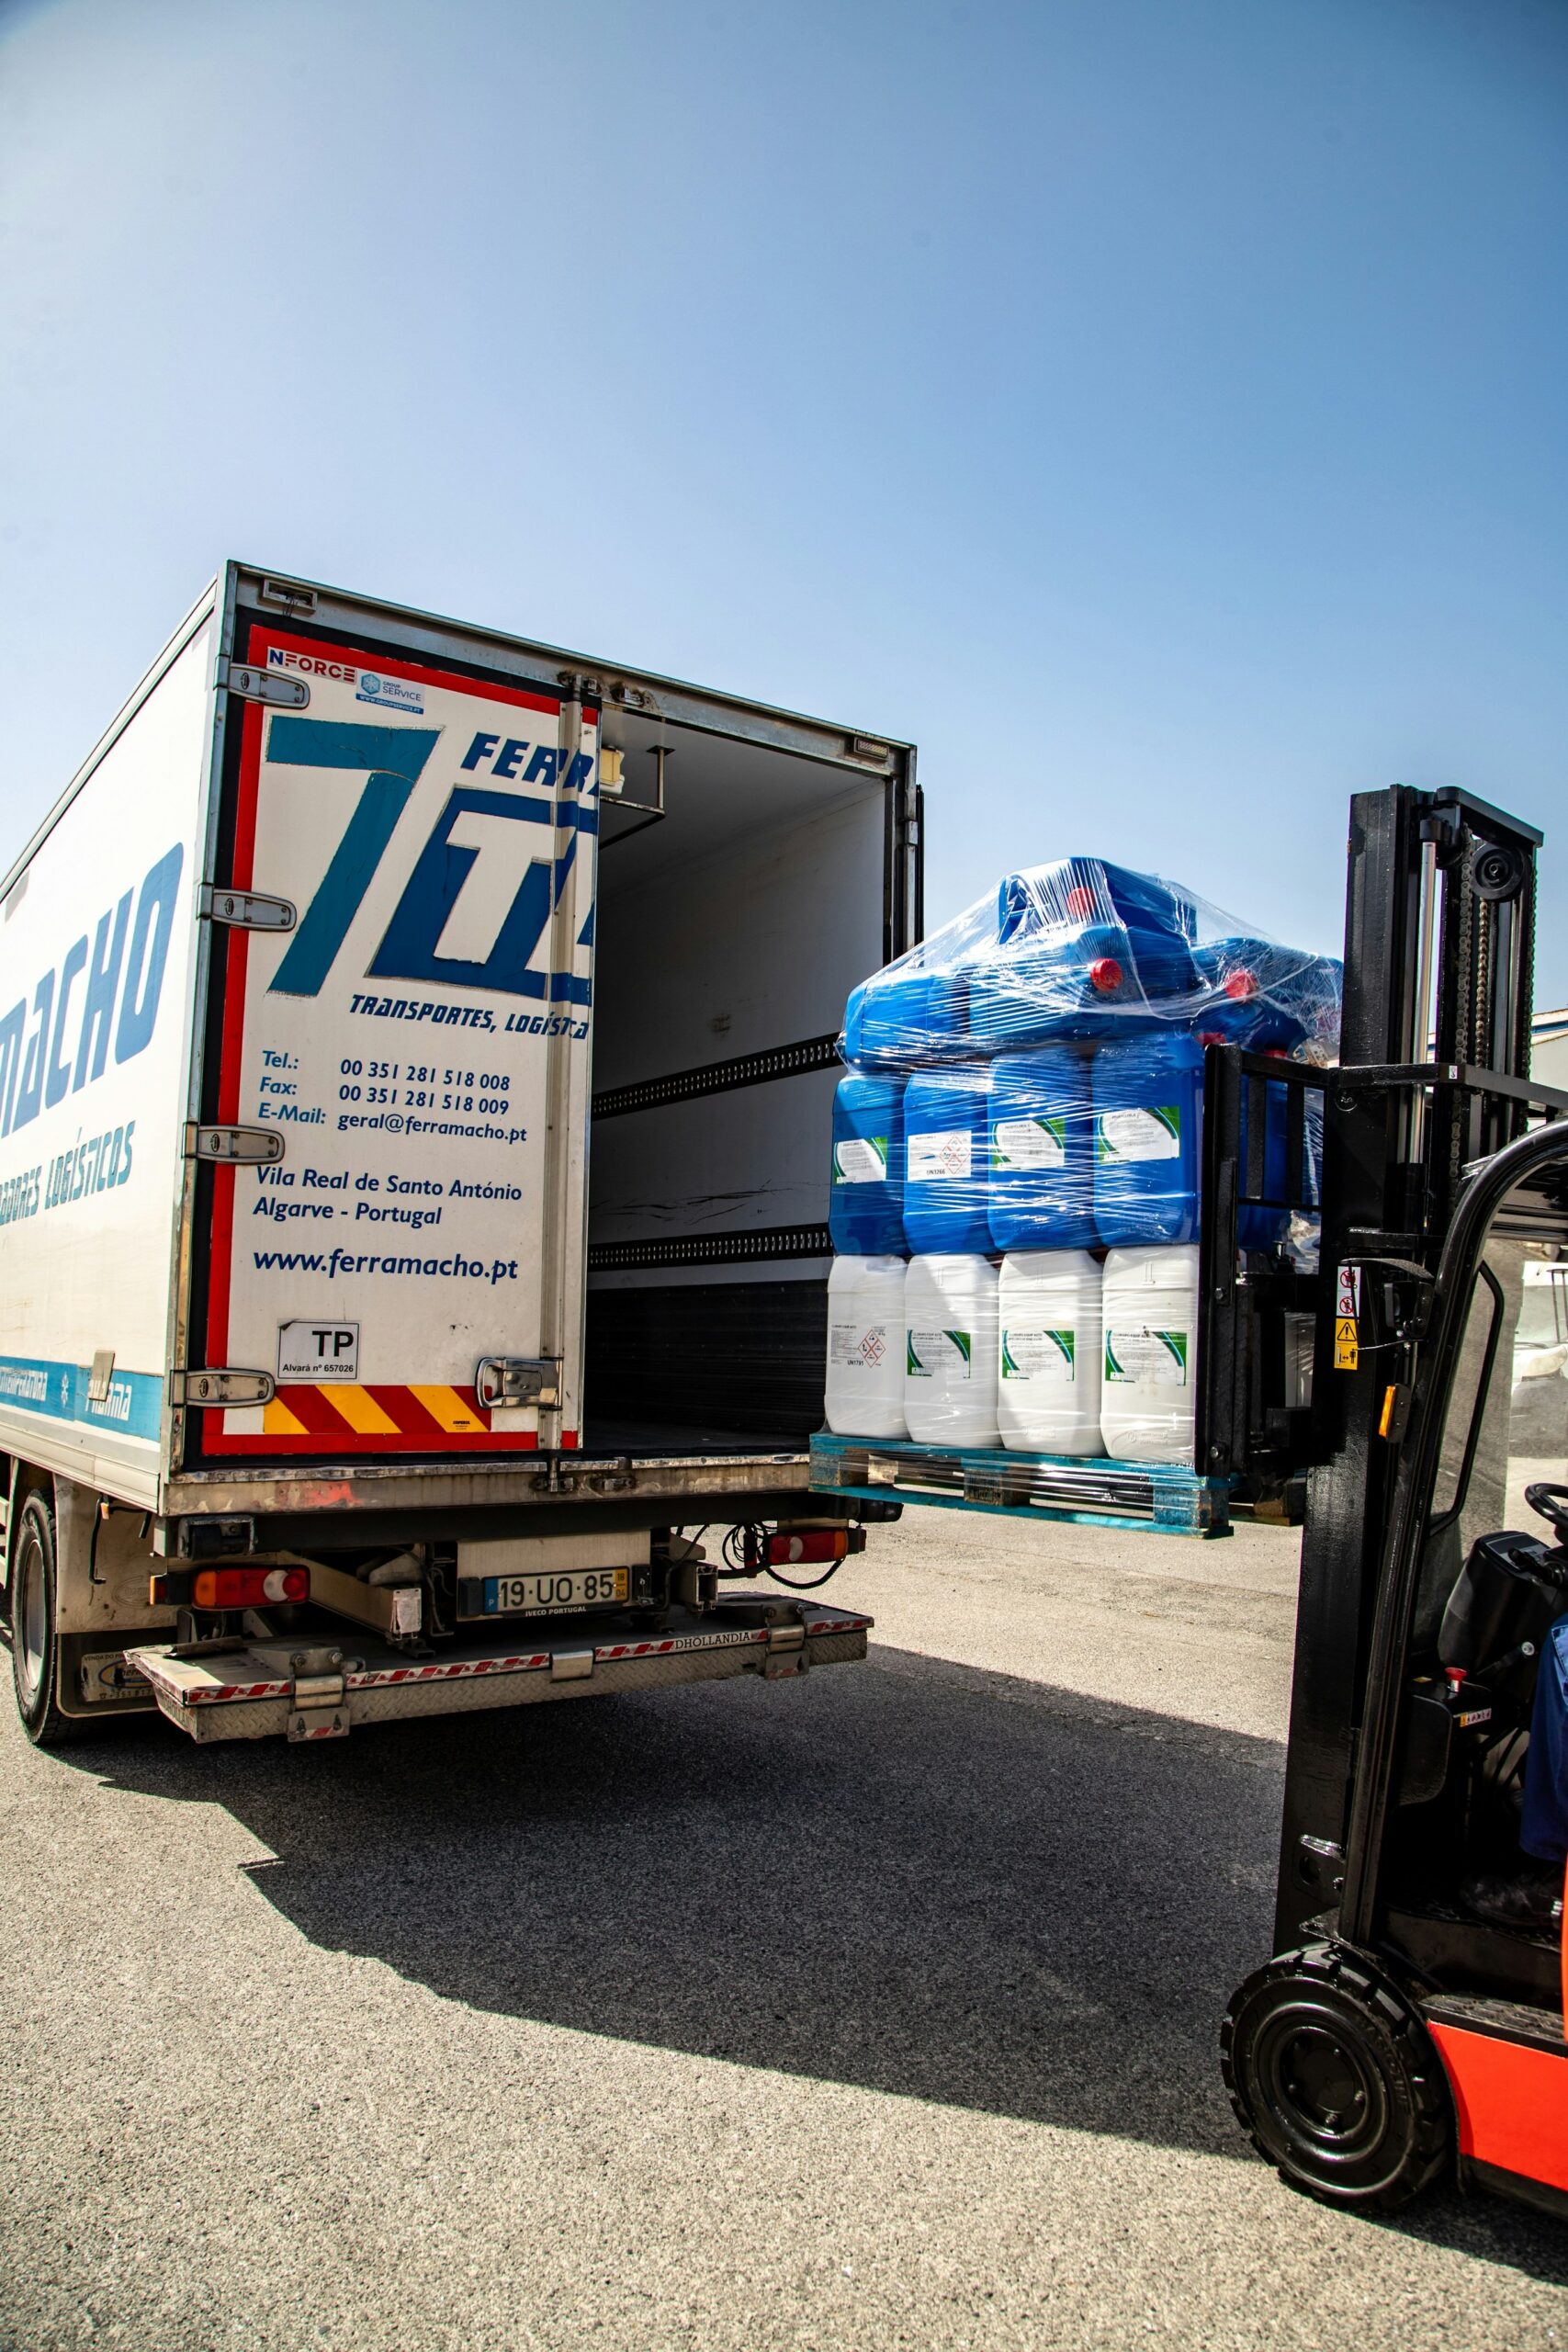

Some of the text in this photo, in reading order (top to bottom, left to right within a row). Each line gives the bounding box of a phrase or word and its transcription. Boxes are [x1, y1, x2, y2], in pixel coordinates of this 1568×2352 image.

[269, 650, 356, 684] NFORCE
[382, 686, 422, 702] SERVICE
[348, 994, 497, 1034] TRANSPORTES,
[262, 1050, 511, 1091] Tel.: 00 351 281 518 008
[259, 1076, 510, 1115] Fax: 00 351 281 518 009
[257, 1102, 528, 1146] E-Mail: geral@ferramacho.pt
[256, 1165, 523, 1201] Vila Real de Santo António
[252, 1196, 334, 1223] Algarve
[355, 1202, 443, 1229] Portugal
[253, 1248, 519, 1285] www.ferramacho.pt
[311, 1330, 355, 1357] TP
[282, 1363, 310, 1372] Alvará
[323, 1364, 355, 1373] 657026
[488, 1599, 495, 1607] P
[616, 1572, 626, 1581] 18
[525, 1606, 587, 1617] IVECO PORTUGAL
[674, 1632, 750, 1650] DHOLLANDIA
